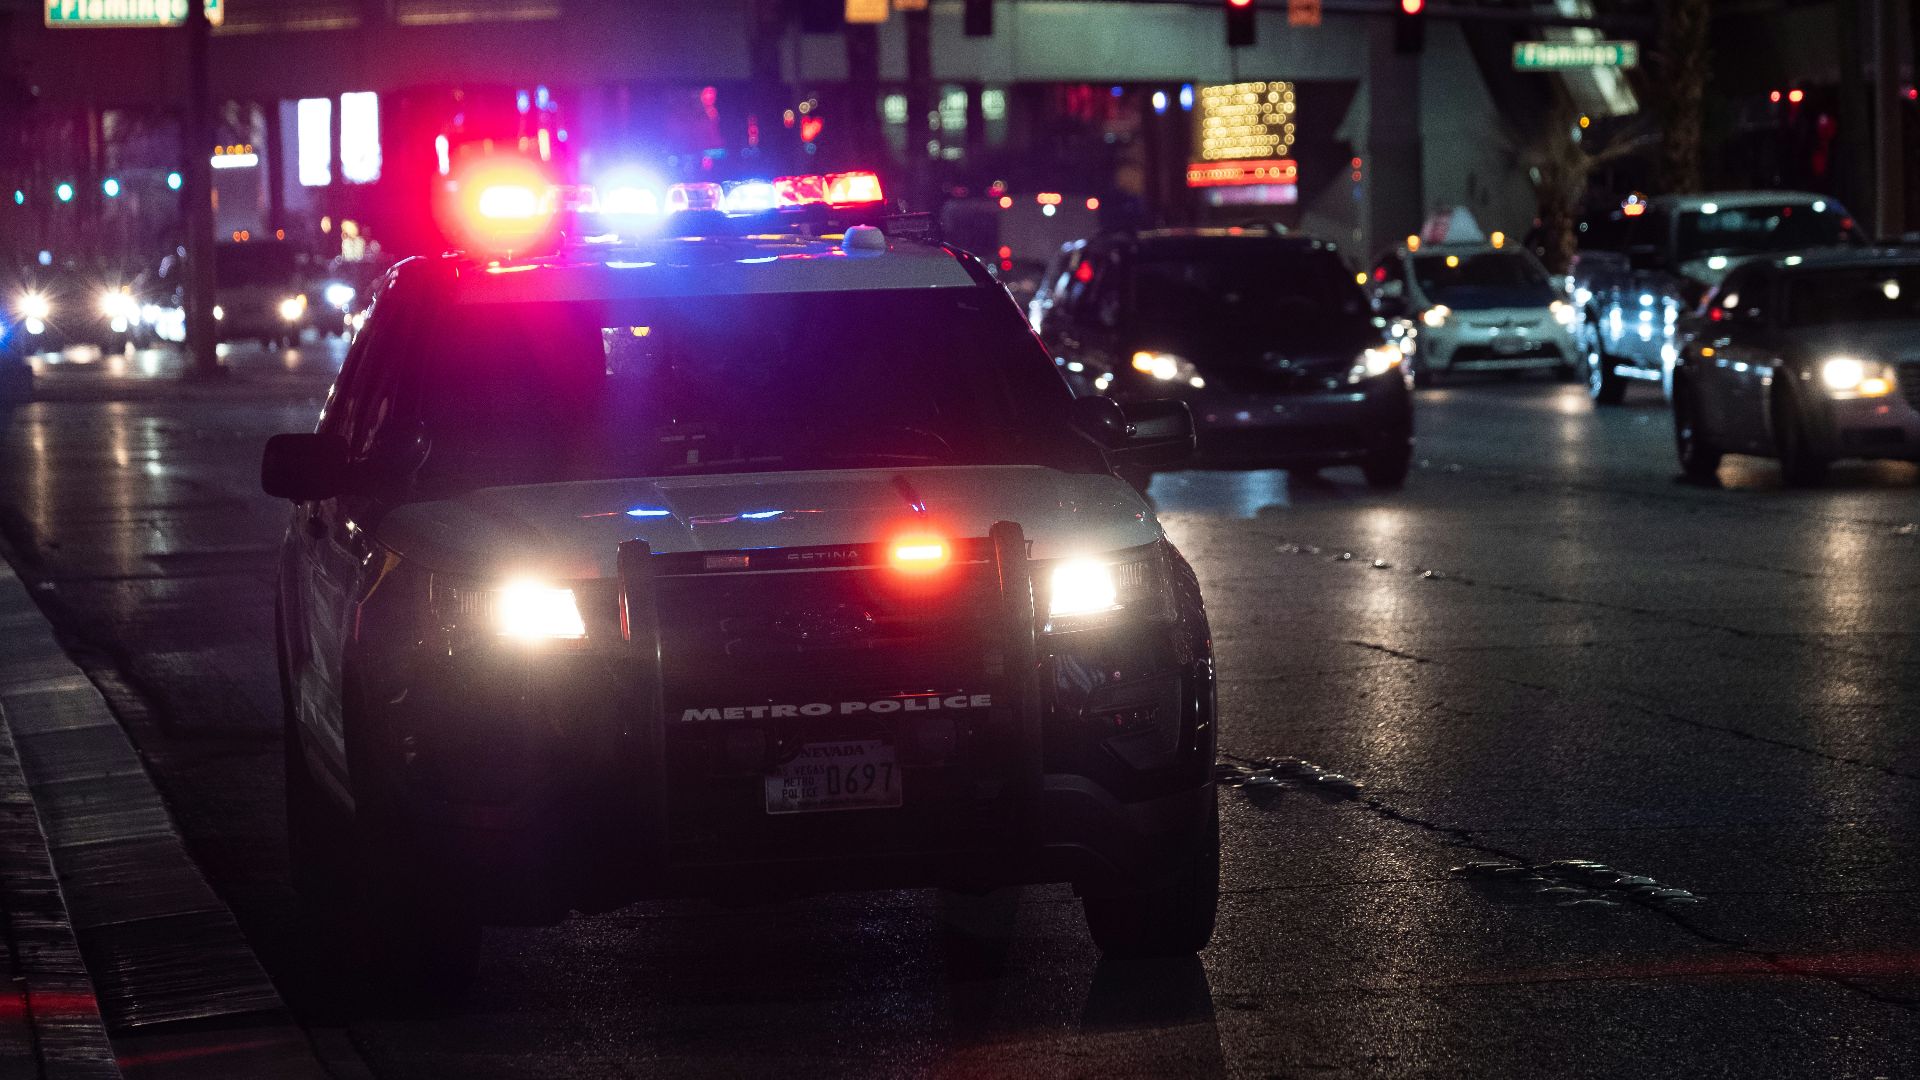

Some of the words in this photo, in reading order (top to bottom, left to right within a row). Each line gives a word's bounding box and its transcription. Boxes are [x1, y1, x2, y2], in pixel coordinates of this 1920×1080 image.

[1524, 43, 1618, 66] Flamingo
[681, 703, 833, 721] METRO
[840, 694, 992, 715] POLICE
[800, 744, 865, 758] NEVADA
[782, 787, 818, 799] POLICE
